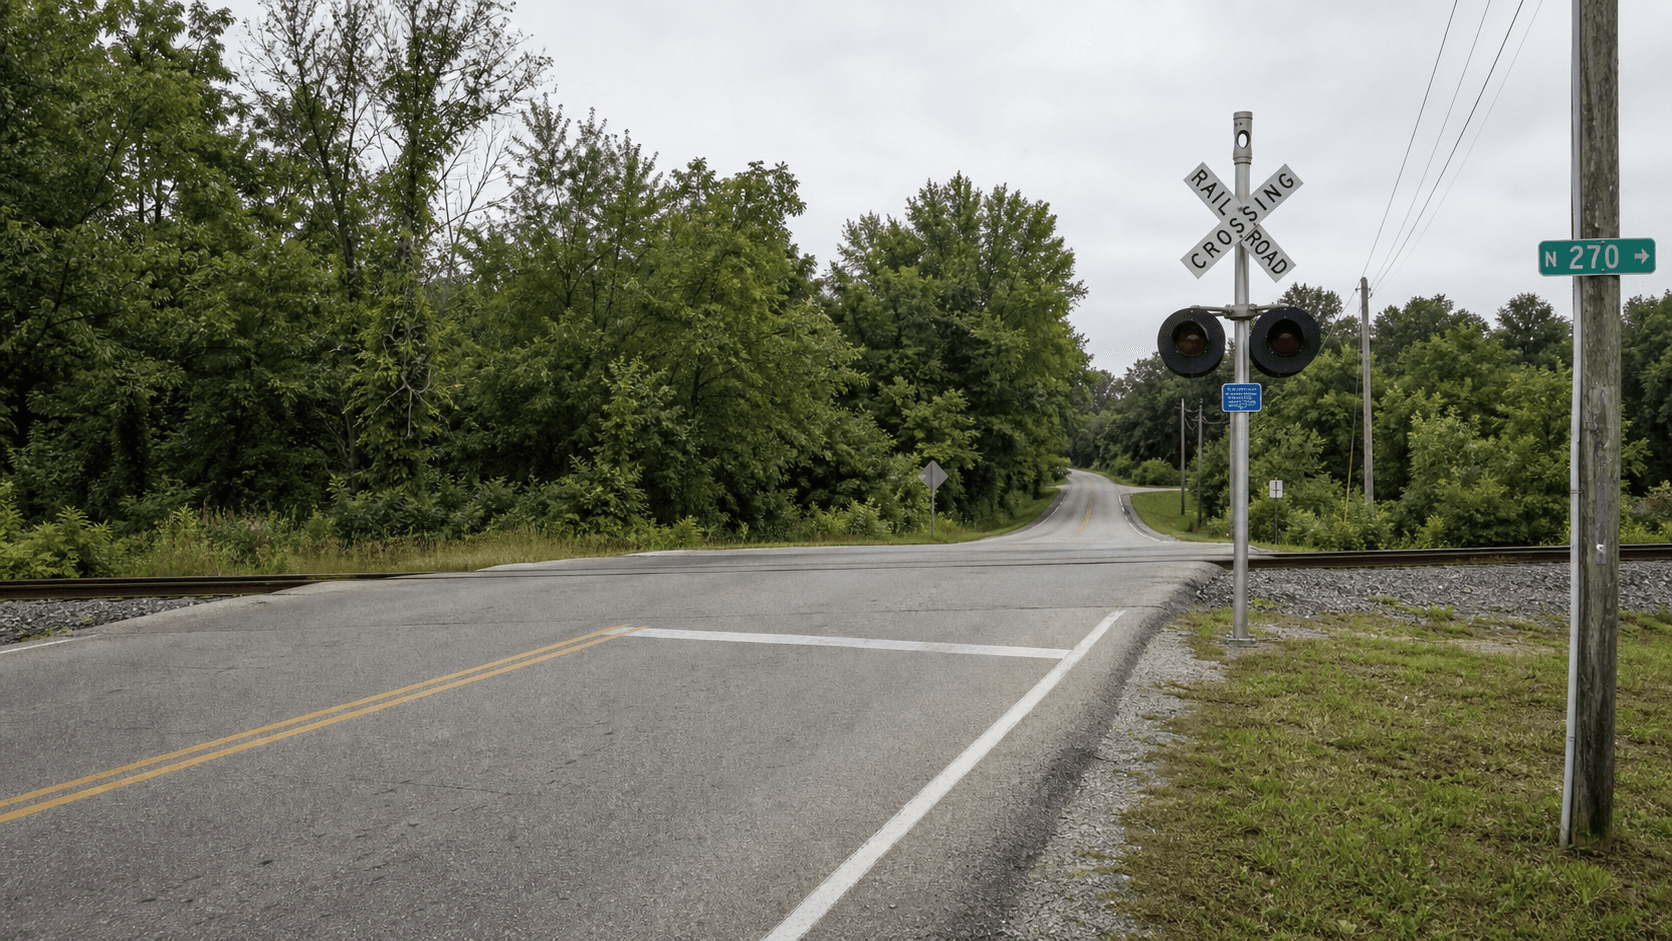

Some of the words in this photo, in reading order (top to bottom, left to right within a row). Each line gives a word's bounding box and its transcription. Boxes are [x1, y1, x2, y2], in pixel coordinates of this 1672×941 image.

[1191, 168, 1231, 216] RAIL
[1245, 229, 1288, 274] ROAD
[1191, 173, 1294, 269] CROSSING
[1545, 251, 1557, 268] N
[1569, 244, 1619, 269] 270
